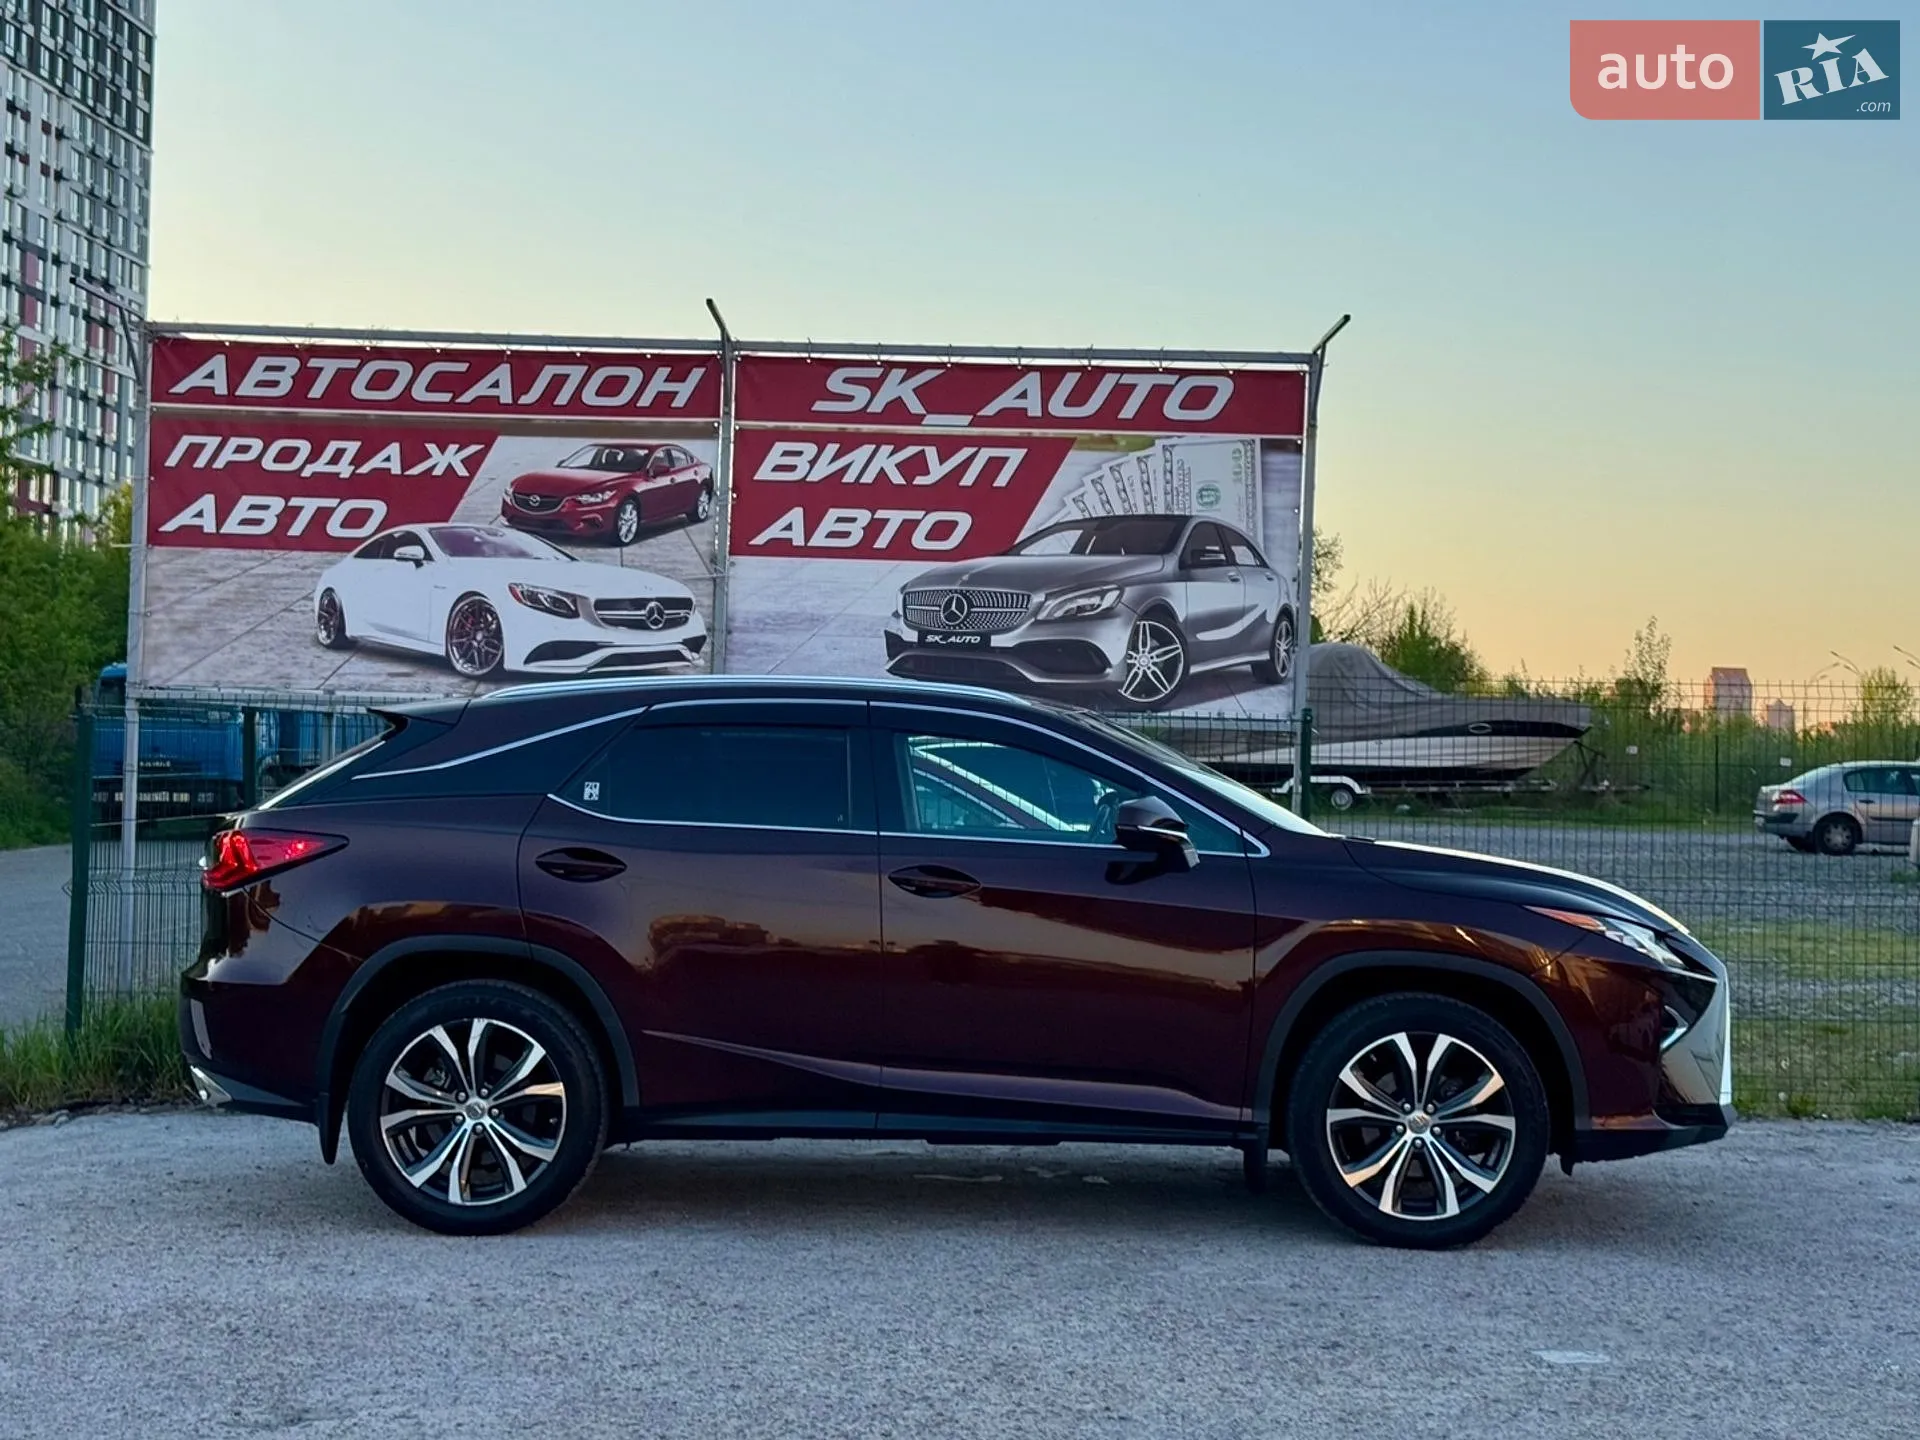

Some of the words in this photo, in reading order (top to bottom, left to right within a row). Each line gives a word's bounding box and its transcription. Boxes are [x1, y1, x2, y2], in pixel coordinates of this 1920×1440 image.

[168, 353, 706, 408] АВТОСАЛОН
[811, 366, 1234, 427] SK_AUTO
[165, 434, 485, 478] ПРОДАЖ
[753, 441, 1028, 487] ВИКУП
[158, 493, 388, 538] АВТО
[748, 506, 973, 551] АВТО
[925, 634, 981, 645] SK_AUTO
